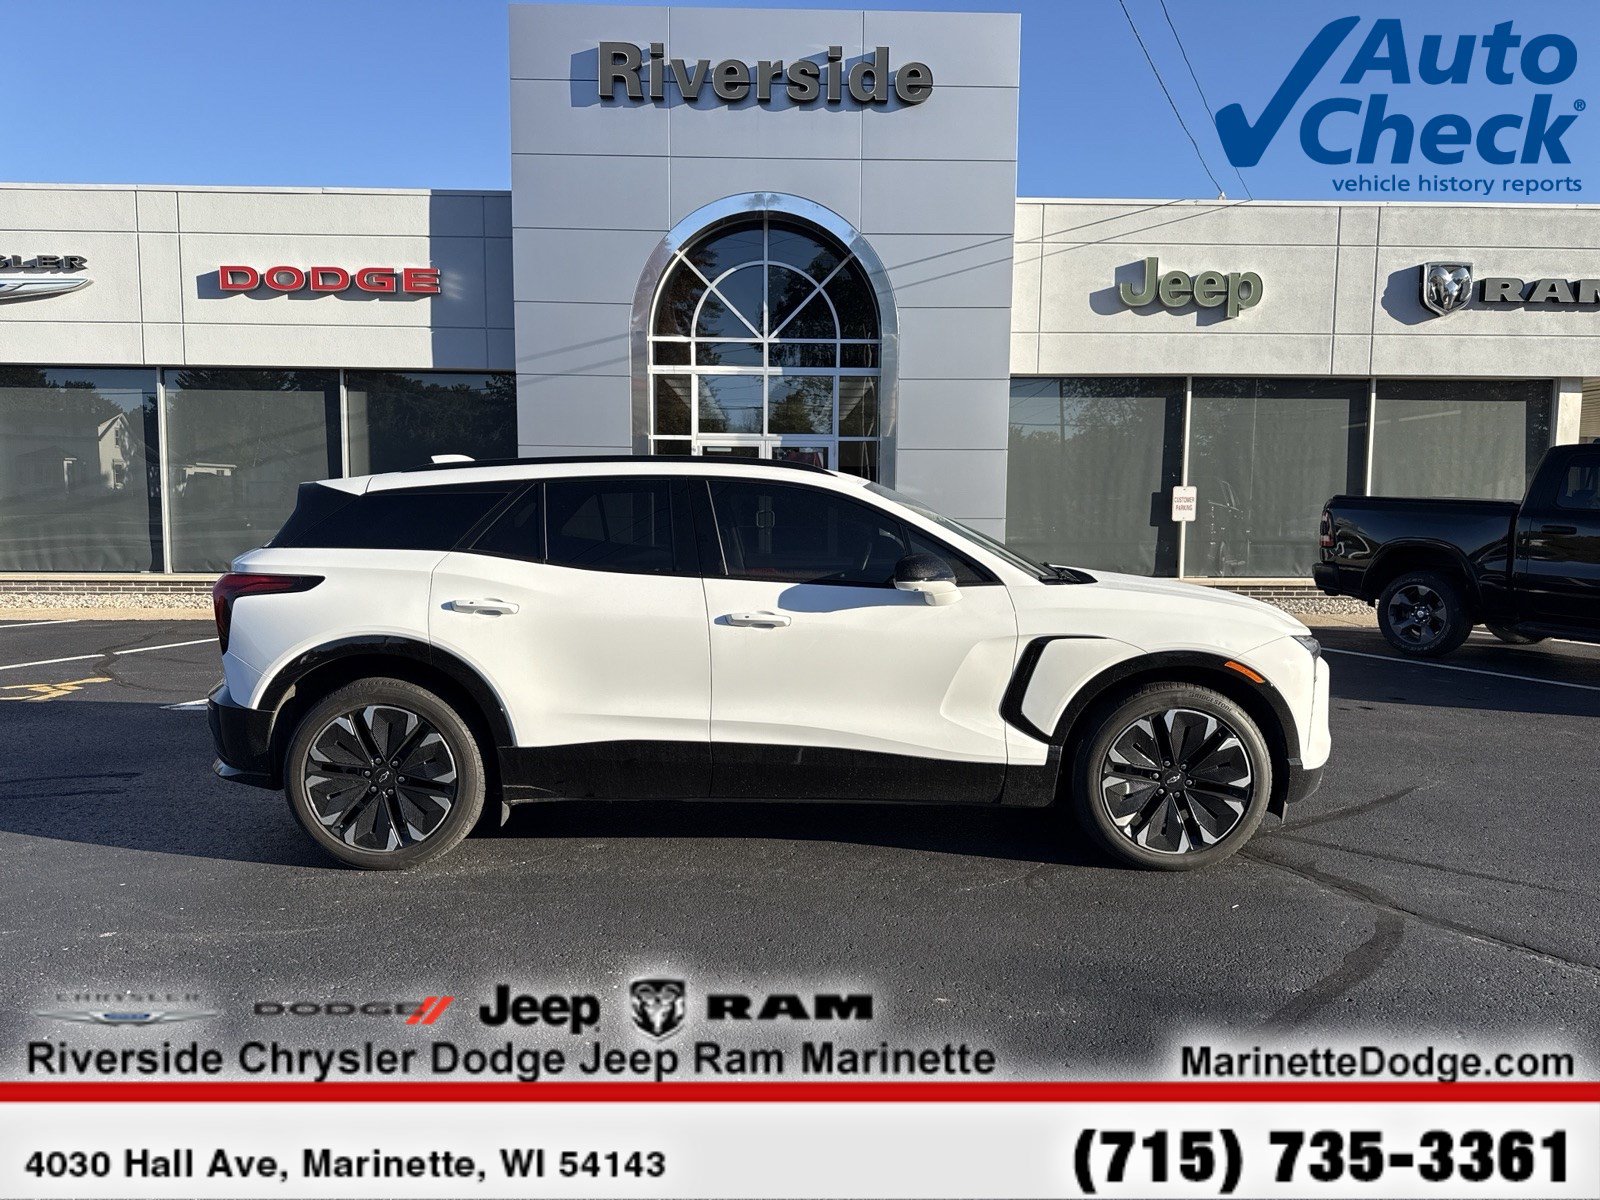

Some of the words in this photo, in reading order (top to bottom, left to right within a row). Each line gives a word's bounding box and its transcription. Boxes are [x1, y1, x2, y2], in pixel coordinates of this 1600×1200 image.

[598, 41, 934, 106] Riverside
[0, 254, 88, 269] LER
[218, 265, 441, 294] DODGE
[1119, 256, 1264, 318] Jeep
[1188, 690, 1233, 713] BRIDGESTONE
